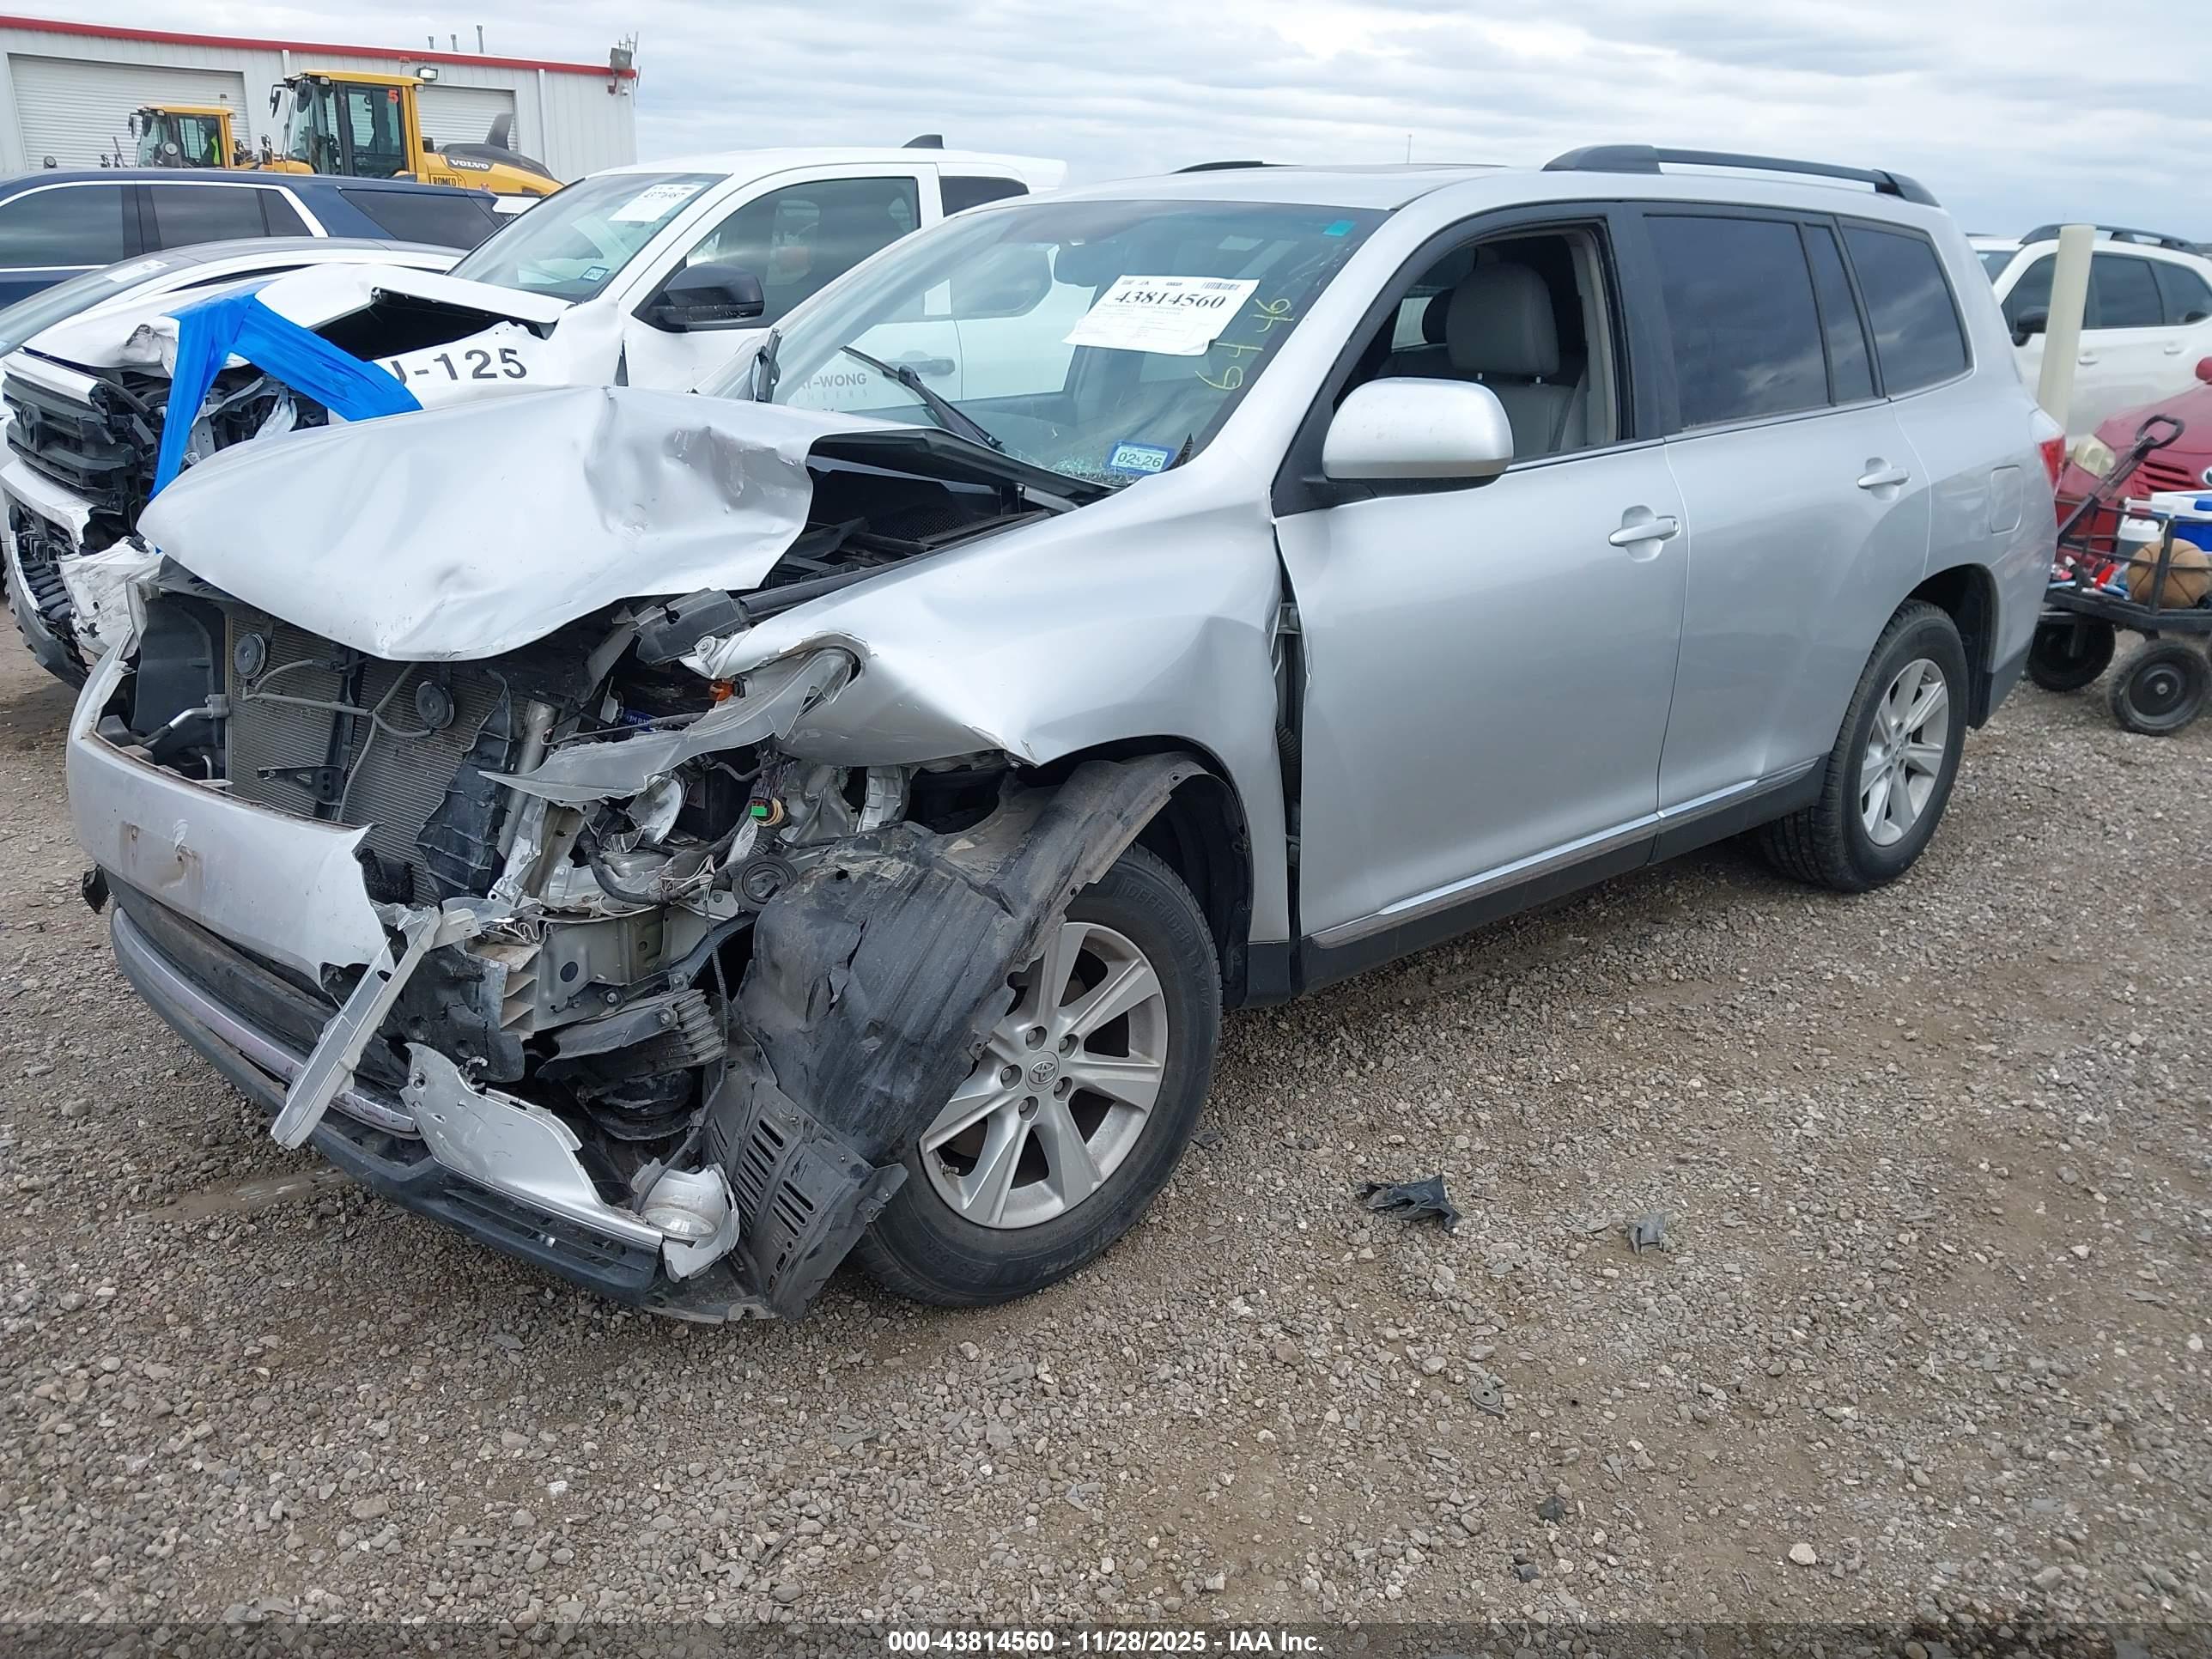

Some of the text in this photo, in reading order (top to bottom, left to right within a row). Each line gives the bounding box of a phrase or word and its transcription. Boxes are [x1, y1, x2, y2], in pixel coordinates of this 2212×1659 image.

[388, 89, 398, 103] 5
[449, 159, 489, 170] VOLVO
[1115, 290, 1227, 309] 43814560
